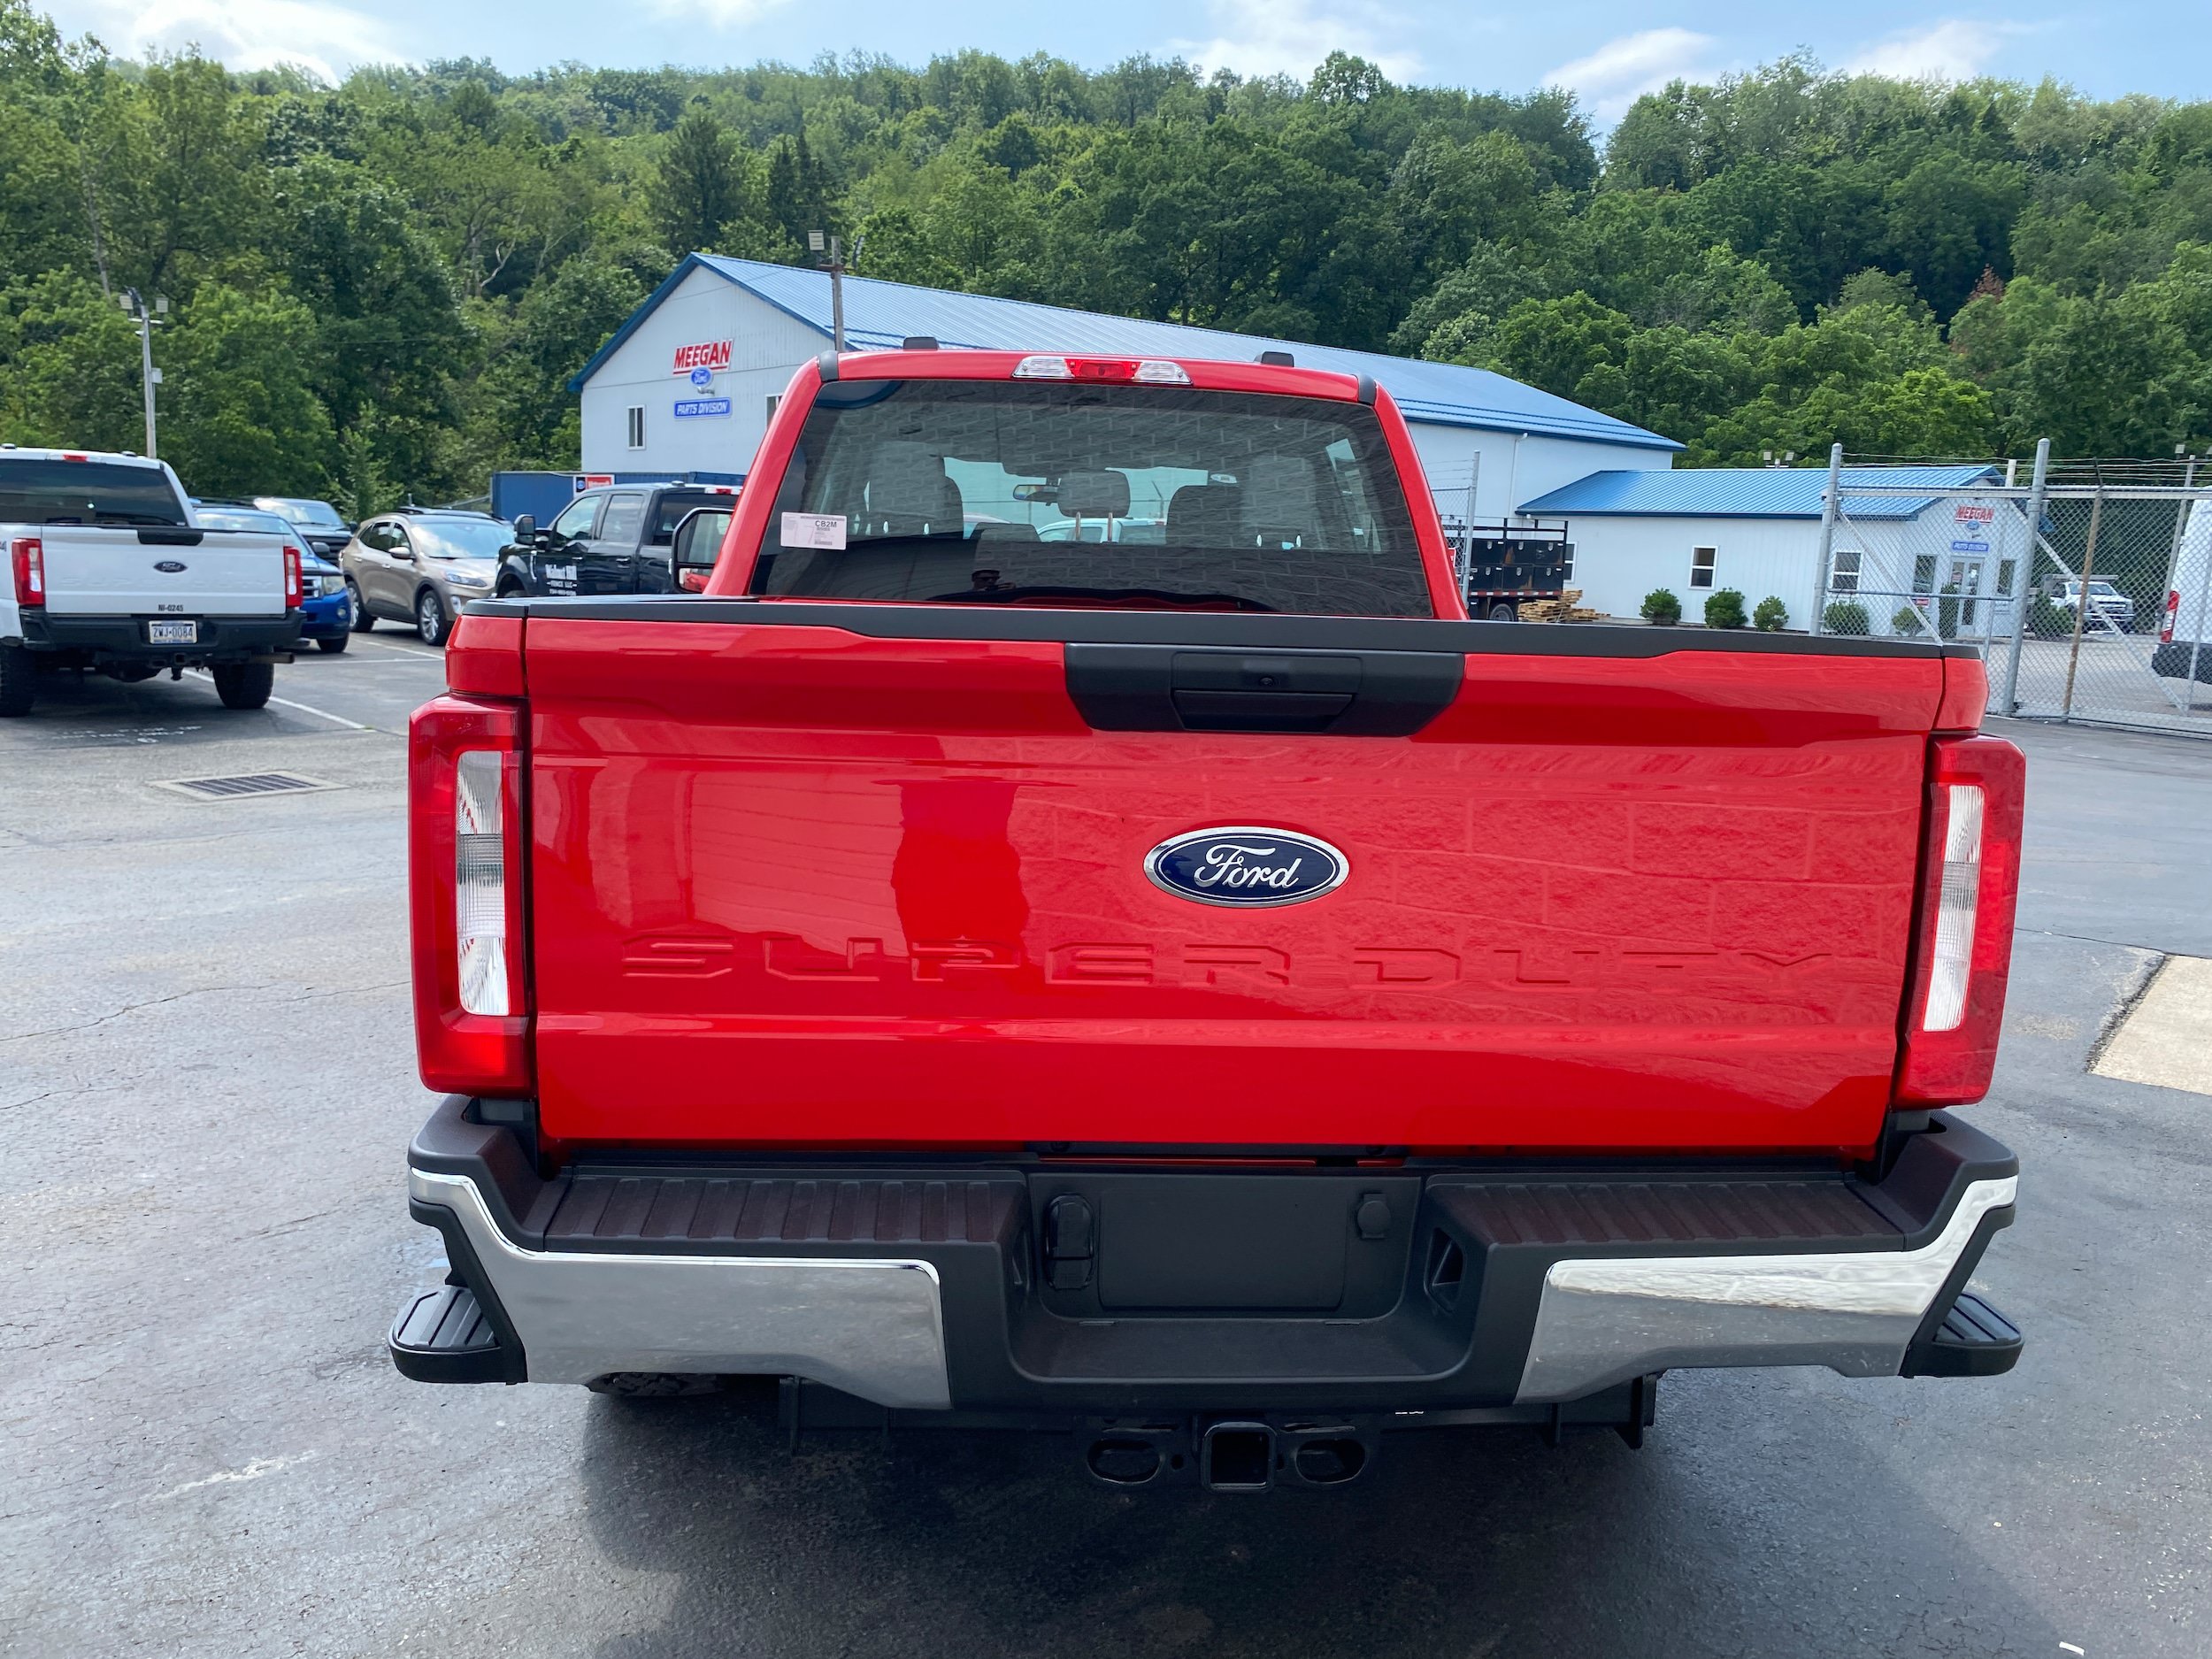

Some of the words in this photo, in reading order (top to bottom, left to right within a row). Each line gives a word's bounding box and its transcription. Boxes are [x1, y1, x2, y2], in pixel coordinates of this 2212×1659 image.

[674, 340, 732, 368] MEEGAN
[676, 403, 698, 416] PARTS
[698, 401, 728, 414] DIVISION
[1956, 506, 1993, 520] MEEGAN
[1194, 844, 1302, 888] Ford
[622, 935, 1291, 986] SUPER
[1349, 947, 1836, 991] DUTY
